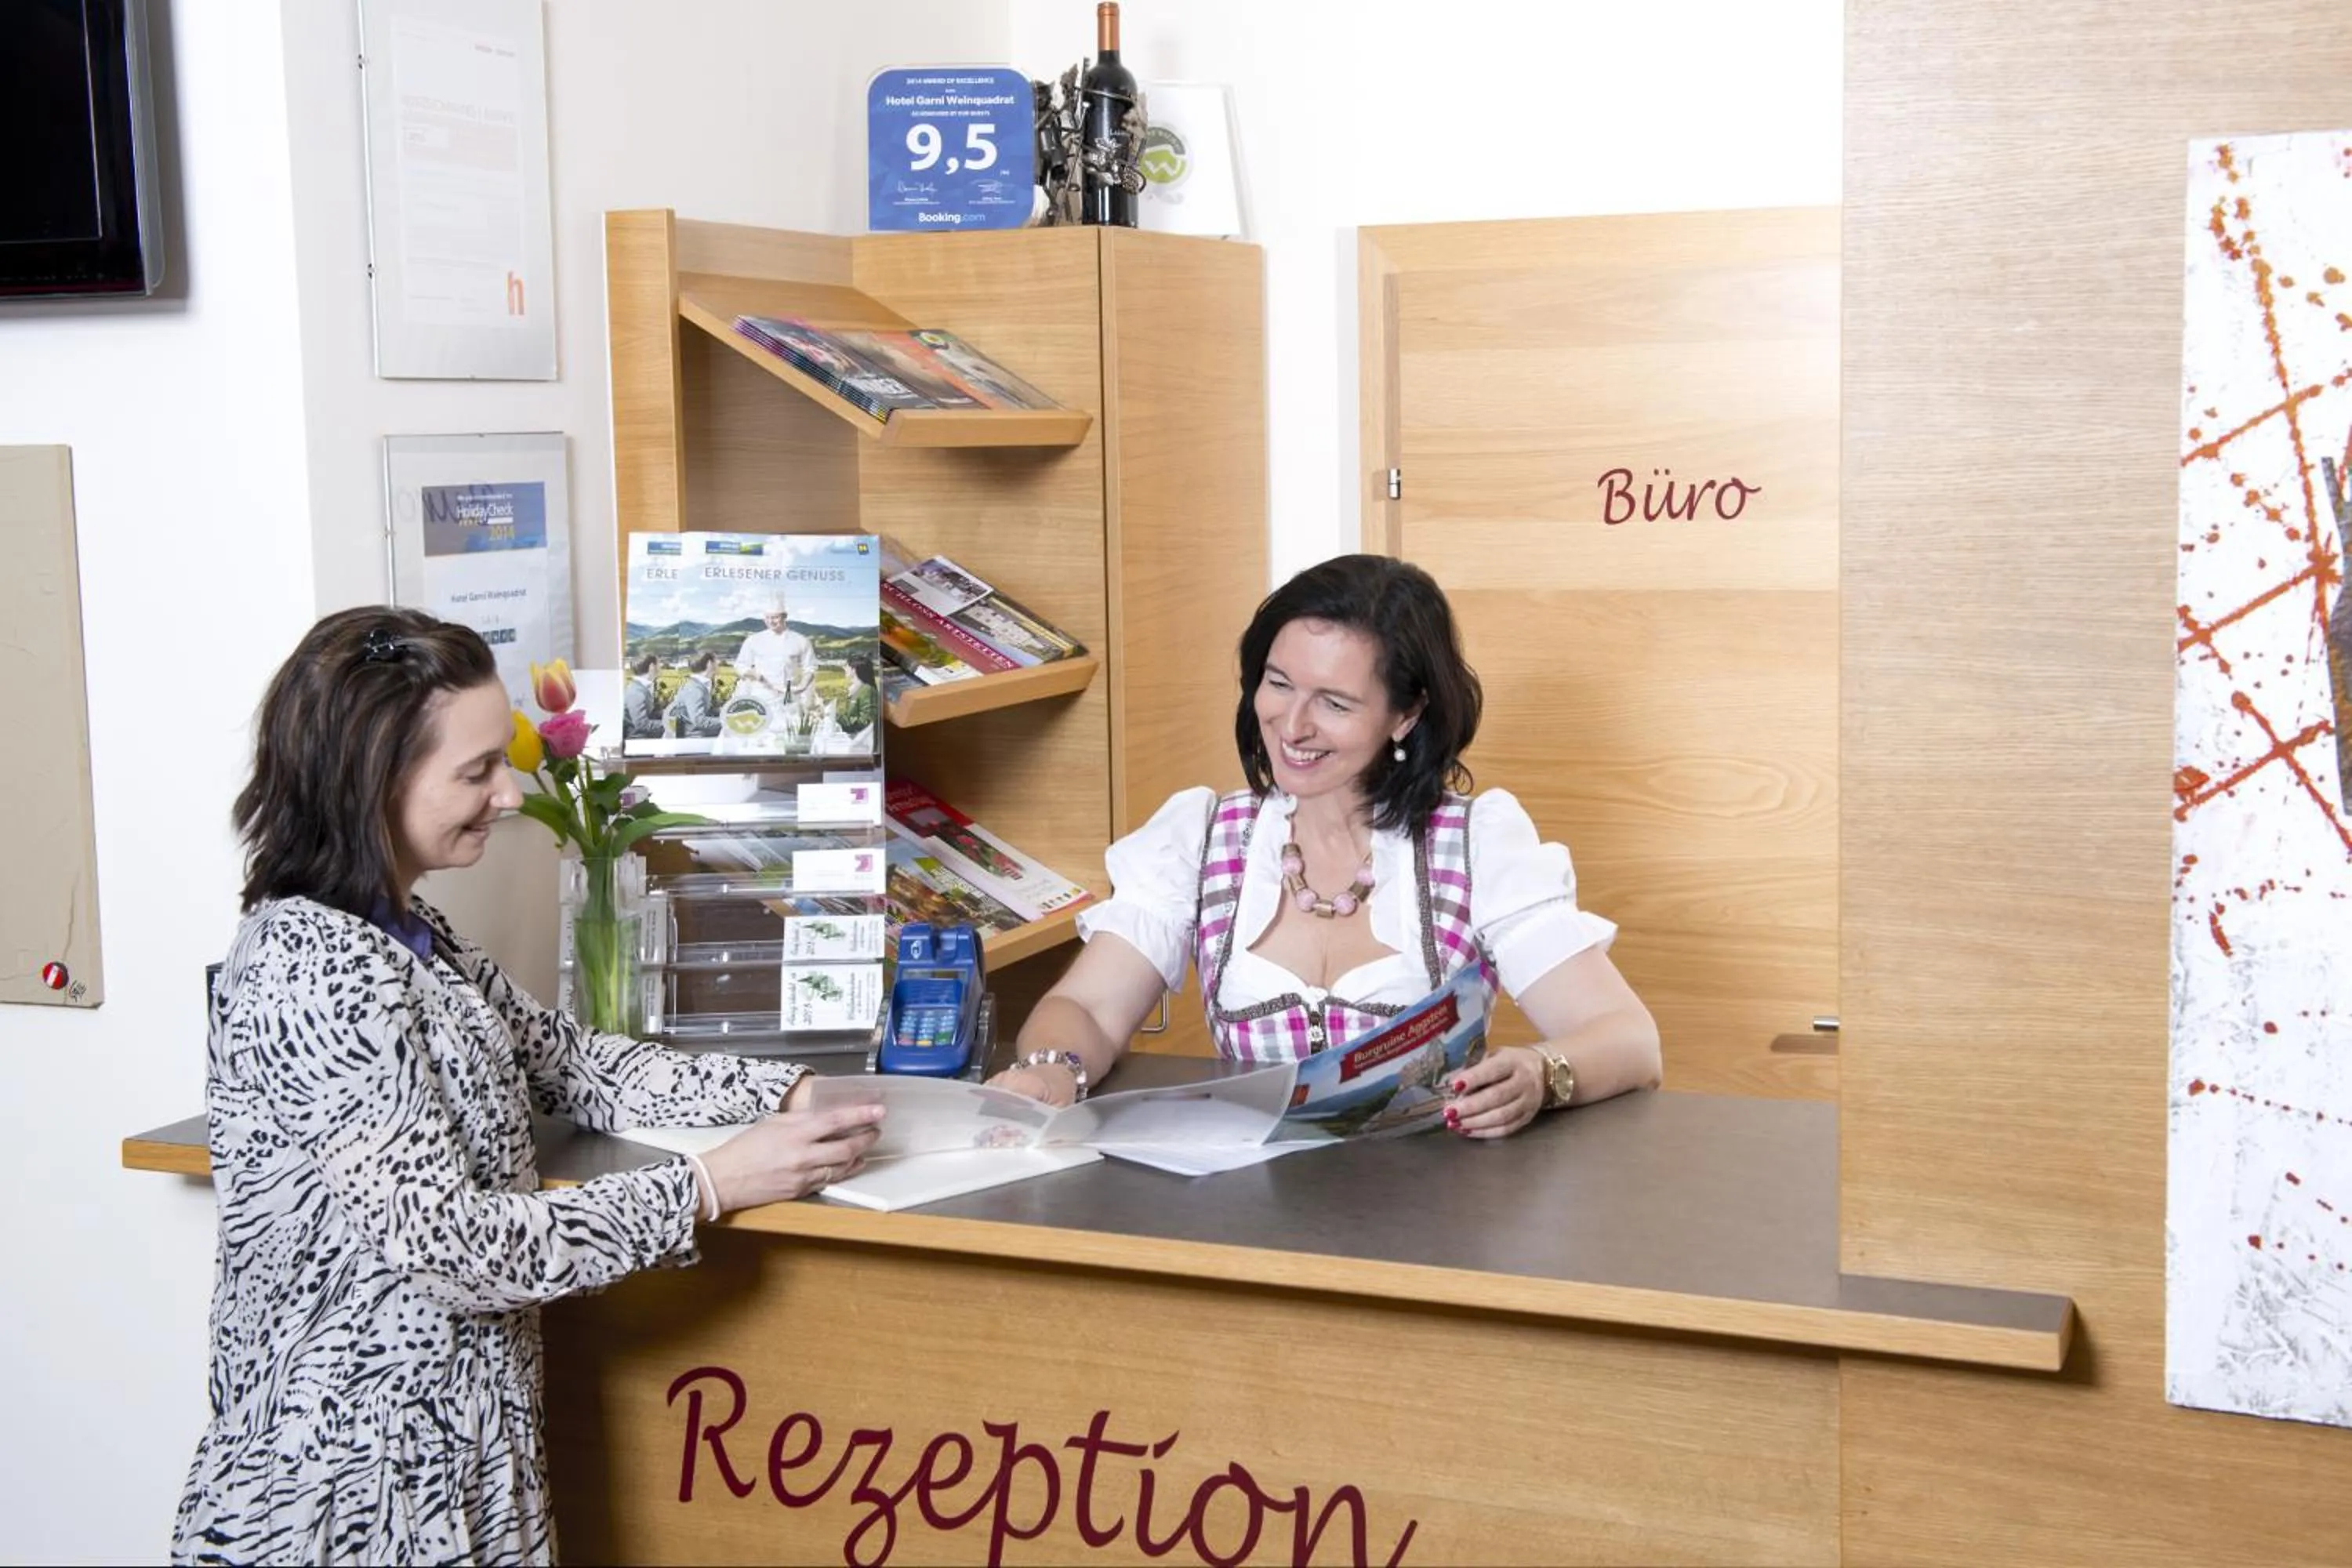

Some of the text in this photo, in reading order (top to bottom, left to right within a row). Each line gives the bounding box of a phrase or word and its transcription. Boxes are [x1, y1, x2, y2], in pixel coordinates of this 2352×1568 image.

[885, 96, 1014, 106] Hotel Garni Weinquadrat
[906, 123, 998, 175] 9,5
[918, 212, 985, 223] Booking.com
[1597, 468, 1762, 524] Büro
[456, 502, 514, 521] HolidayCheck
[705, 567, 845, 581] ERLESENER GENUSS
[1354, 1032, 1406, 1064] Burgruine
[666, 1365, 1418, 1568] Rezeption
